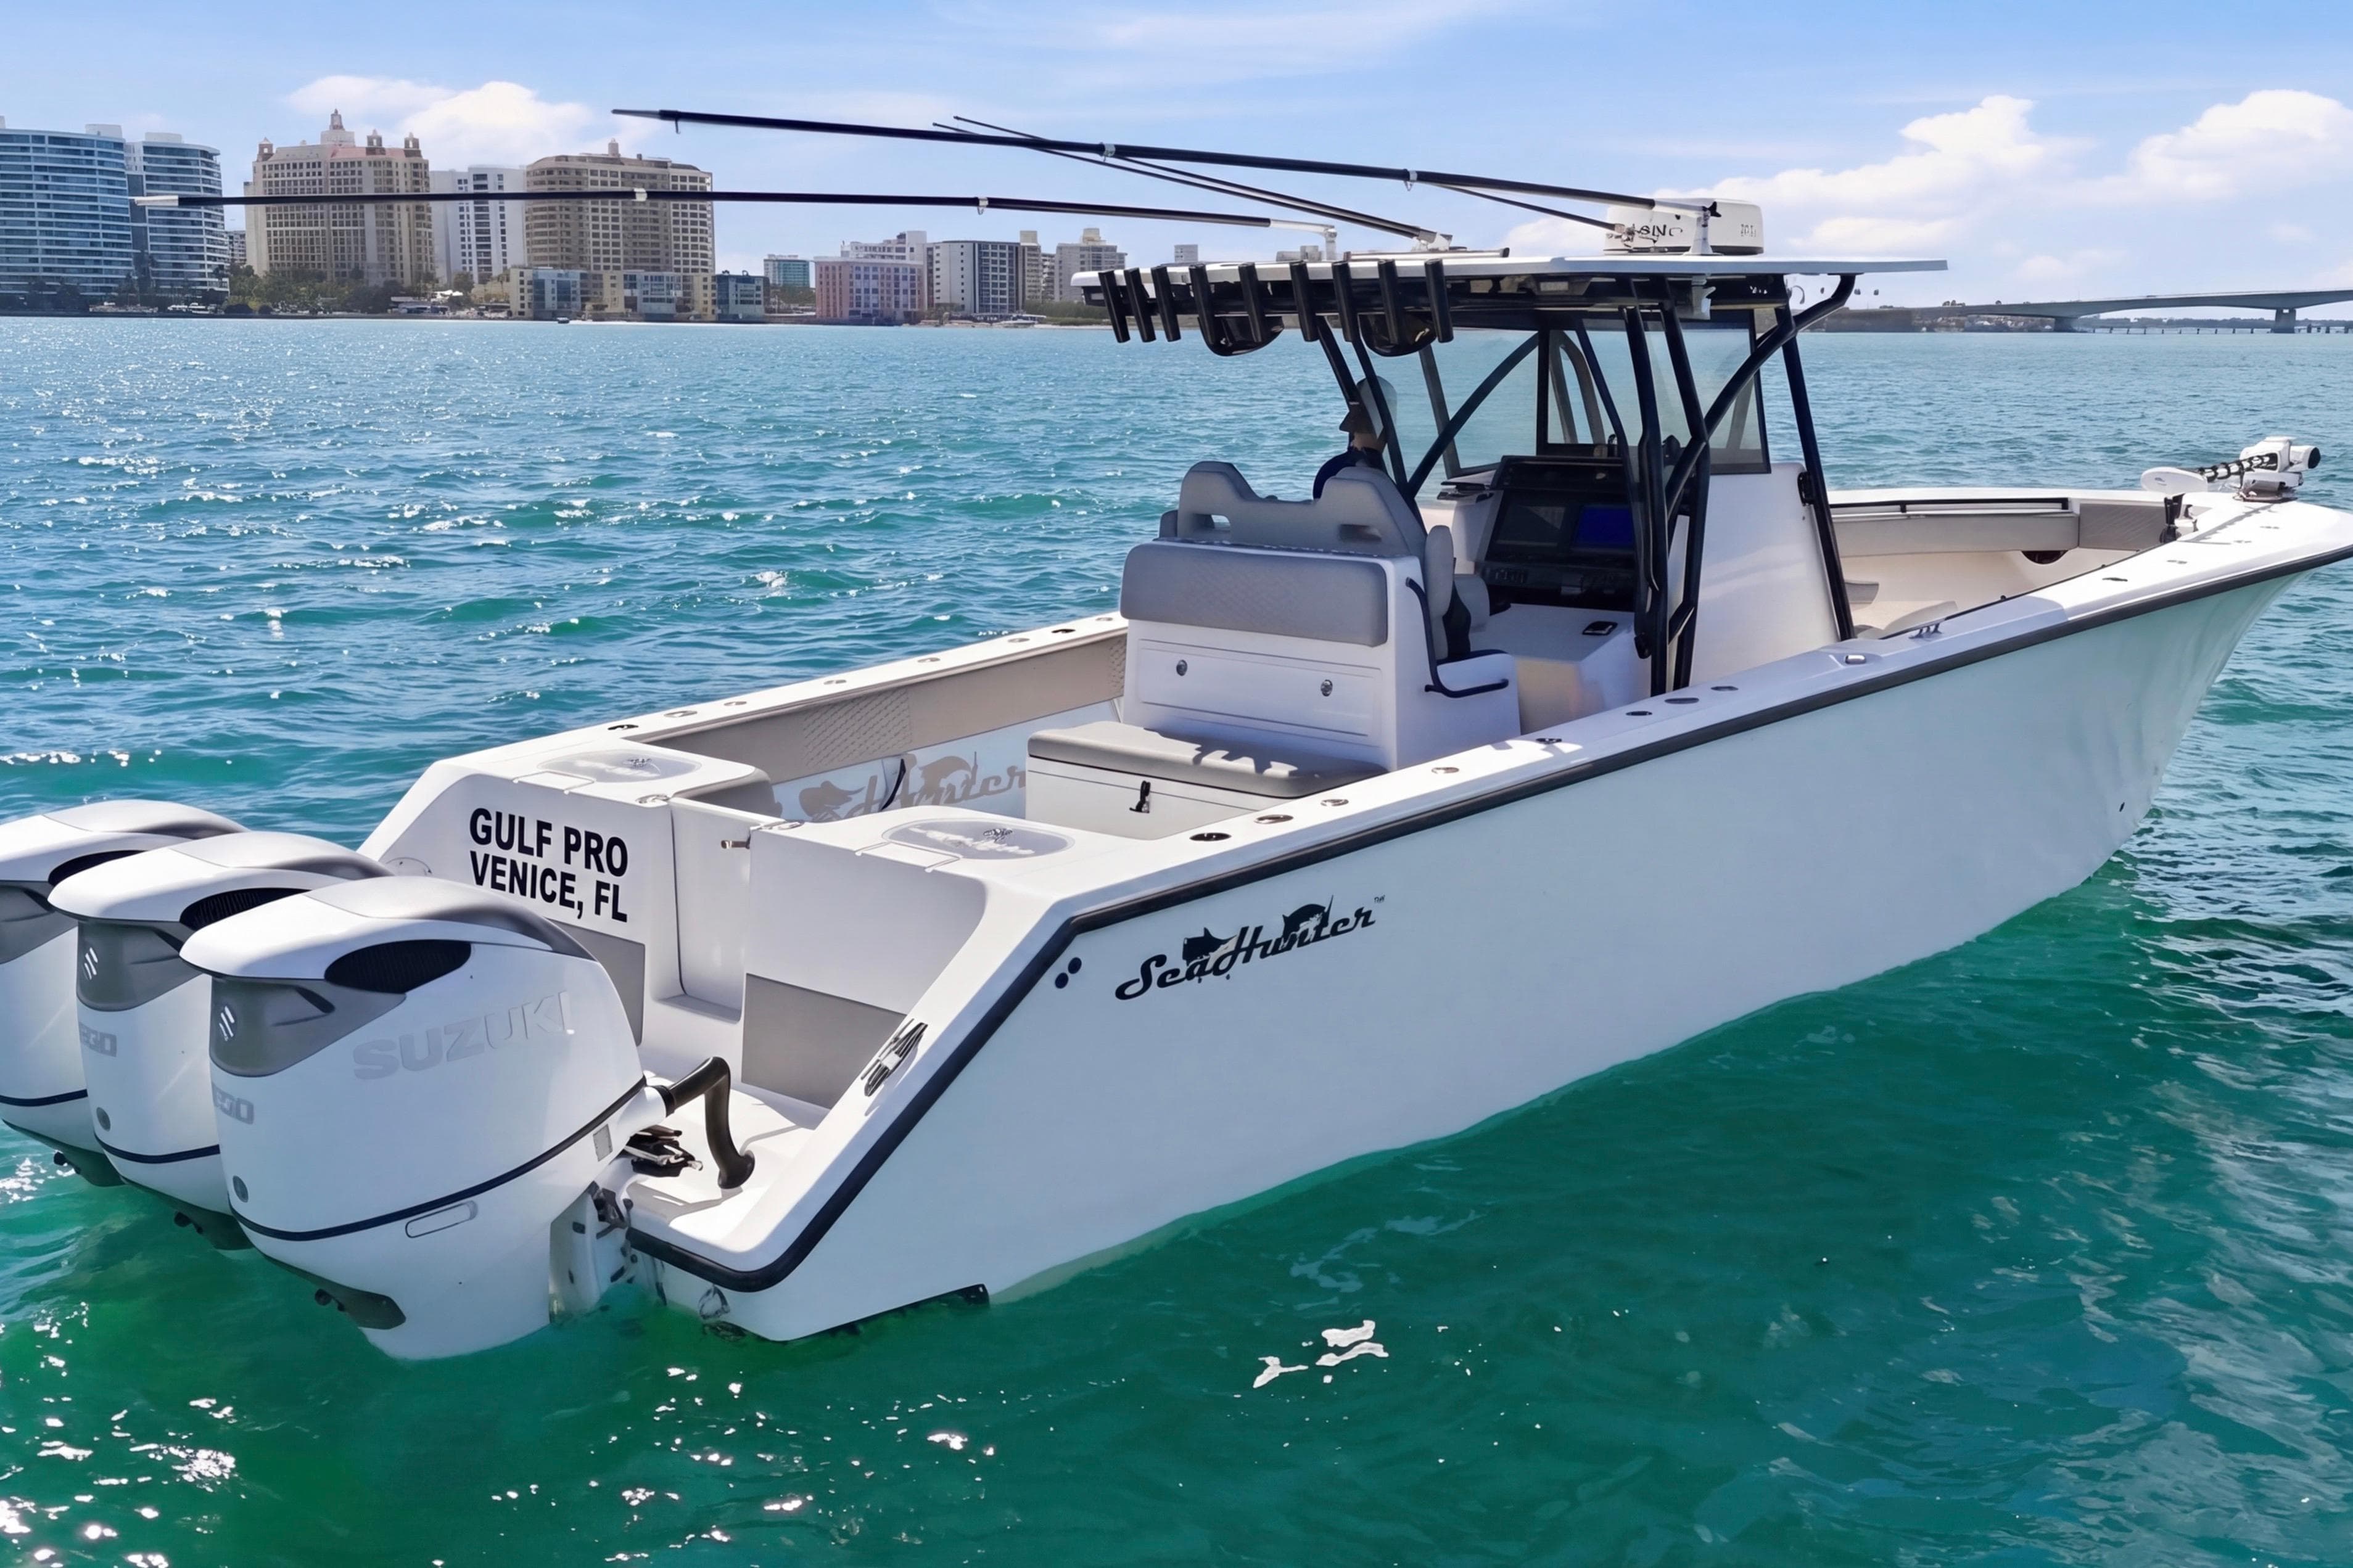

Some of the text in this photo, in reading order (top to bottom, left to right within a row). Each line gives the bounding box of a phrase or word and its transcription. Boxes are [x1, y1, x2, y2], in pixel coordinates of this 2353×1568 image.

[469, 807, 628, 877] GULF PRO
[469, 850, 628, 923] VENICE, FL
[352, 990, 574, 1080] SUZUKI
